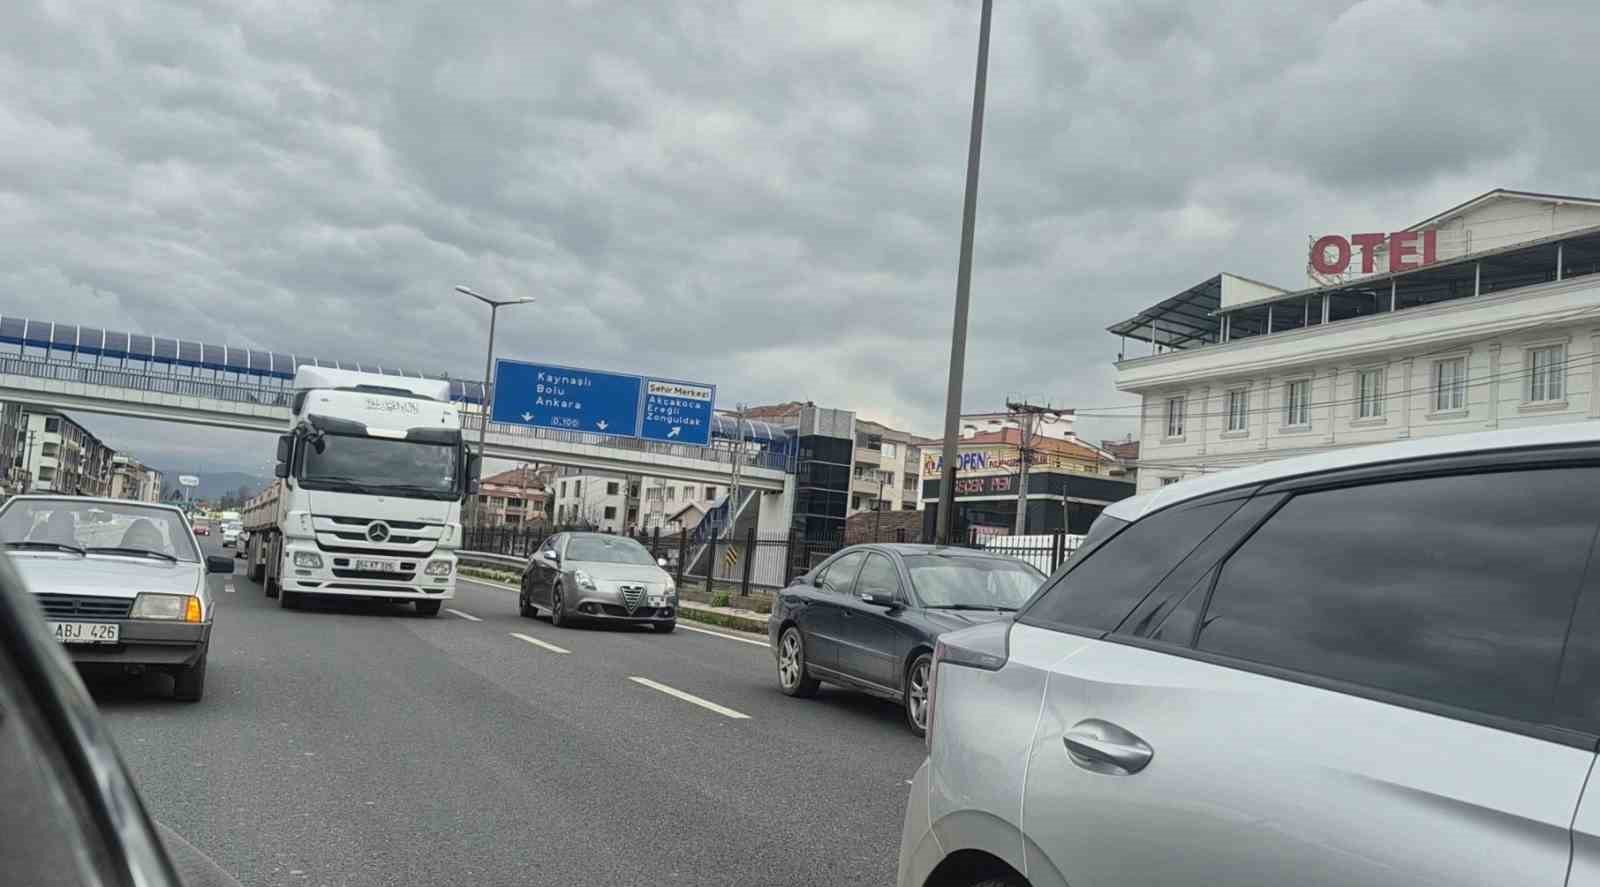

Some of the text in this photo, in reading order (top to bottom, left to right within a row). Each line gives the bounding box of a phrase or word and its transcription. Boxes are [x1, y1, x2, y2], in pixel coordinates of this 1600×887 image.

[536, 384, 565, 395] Bolu
[674, 386, 709, 398] Merkezi
[535, 396, 582, 409] Ankara
[646, 412, 701, 425] Zonguldak
[55, 623, 116, 639] ABJ 426
